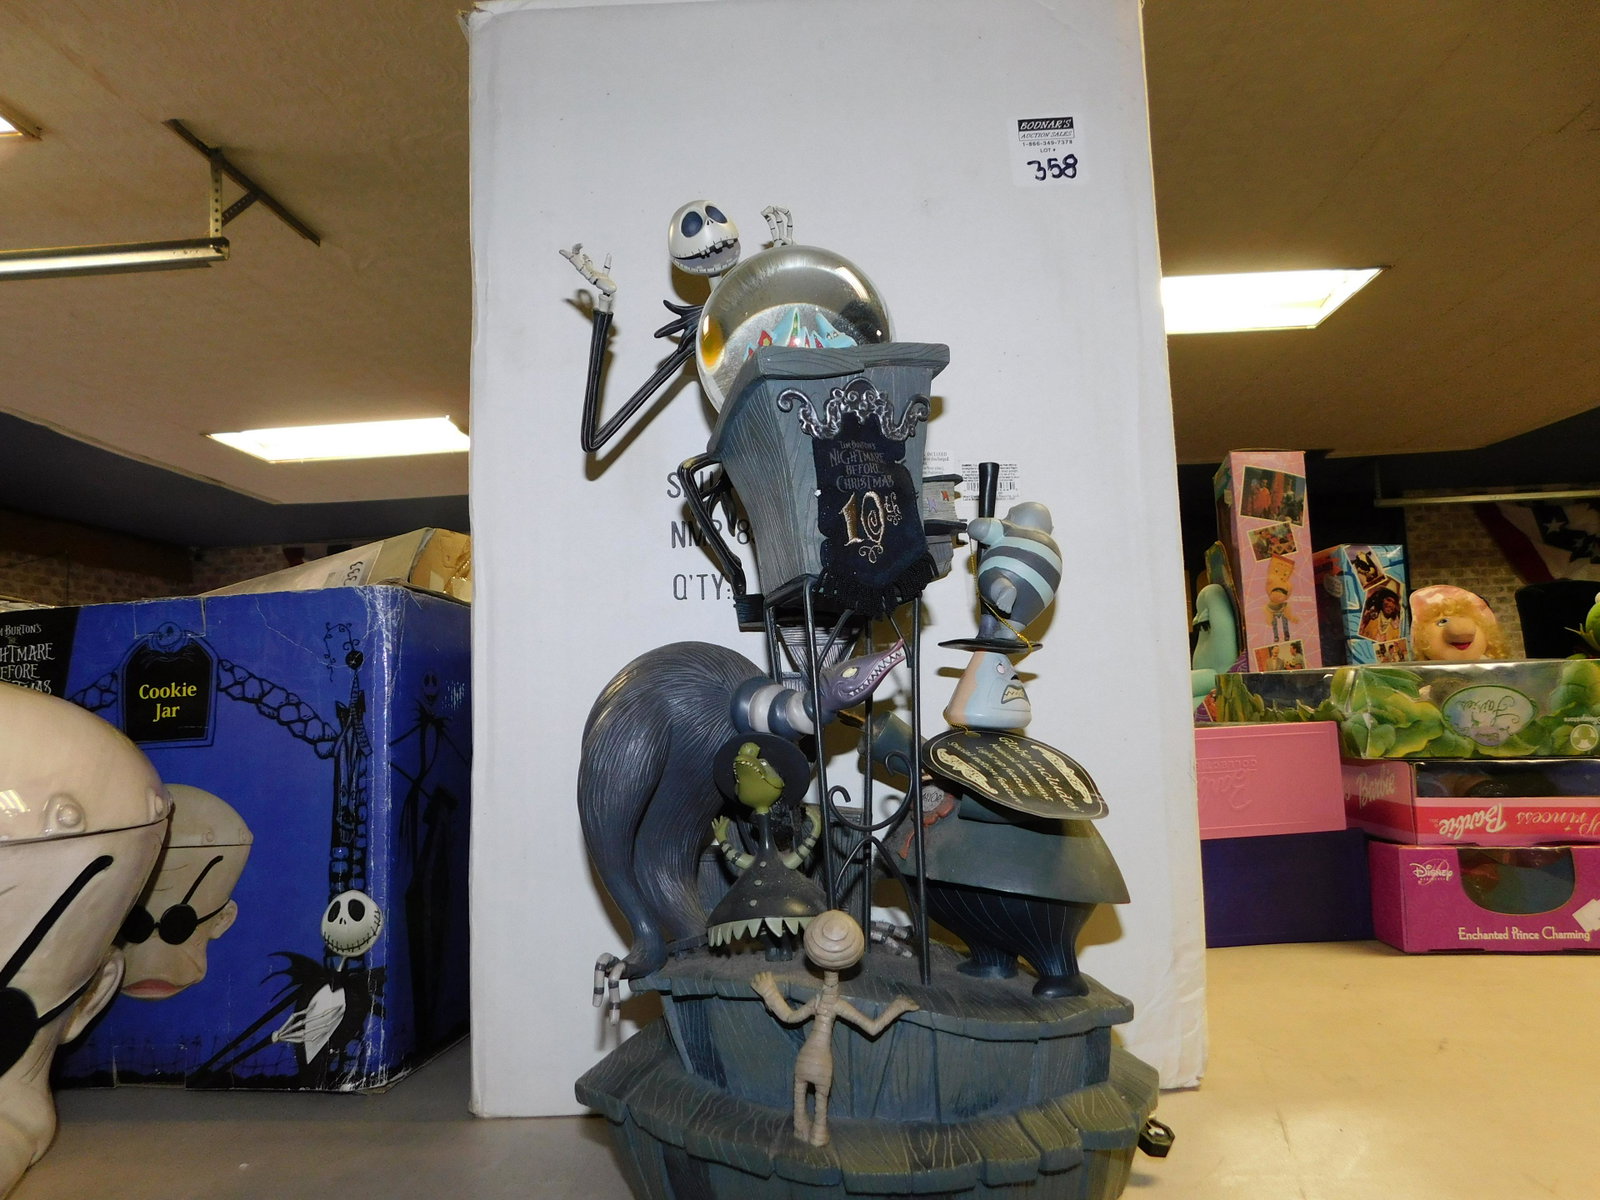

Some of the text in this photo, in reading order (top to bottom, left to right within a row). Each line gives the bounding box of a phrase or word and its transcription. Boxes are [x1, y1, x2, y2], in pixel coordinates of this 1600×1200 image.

[1020, 119, 1072, 130] BODNAR'S
[1027, 154, 1078, 181] 358
[829, 448, 885, 467] NIGHTMARE
[846, 463, 884, 475] BEFORE
[836, 475, 894, 493] CHRISTMAS
[5, 623, 42, 637] BURTON'S
[139, 682, 197, 699] Cookie
[153, 703, 180, 722] Jar
[999, 736, 1031, 760] Globe
[1438, 803, 1507, 840] Barbie
[1409, 862, 1453, 881] Disney
[1458, 926, 1591, 942] Enchanted Prince Charming
